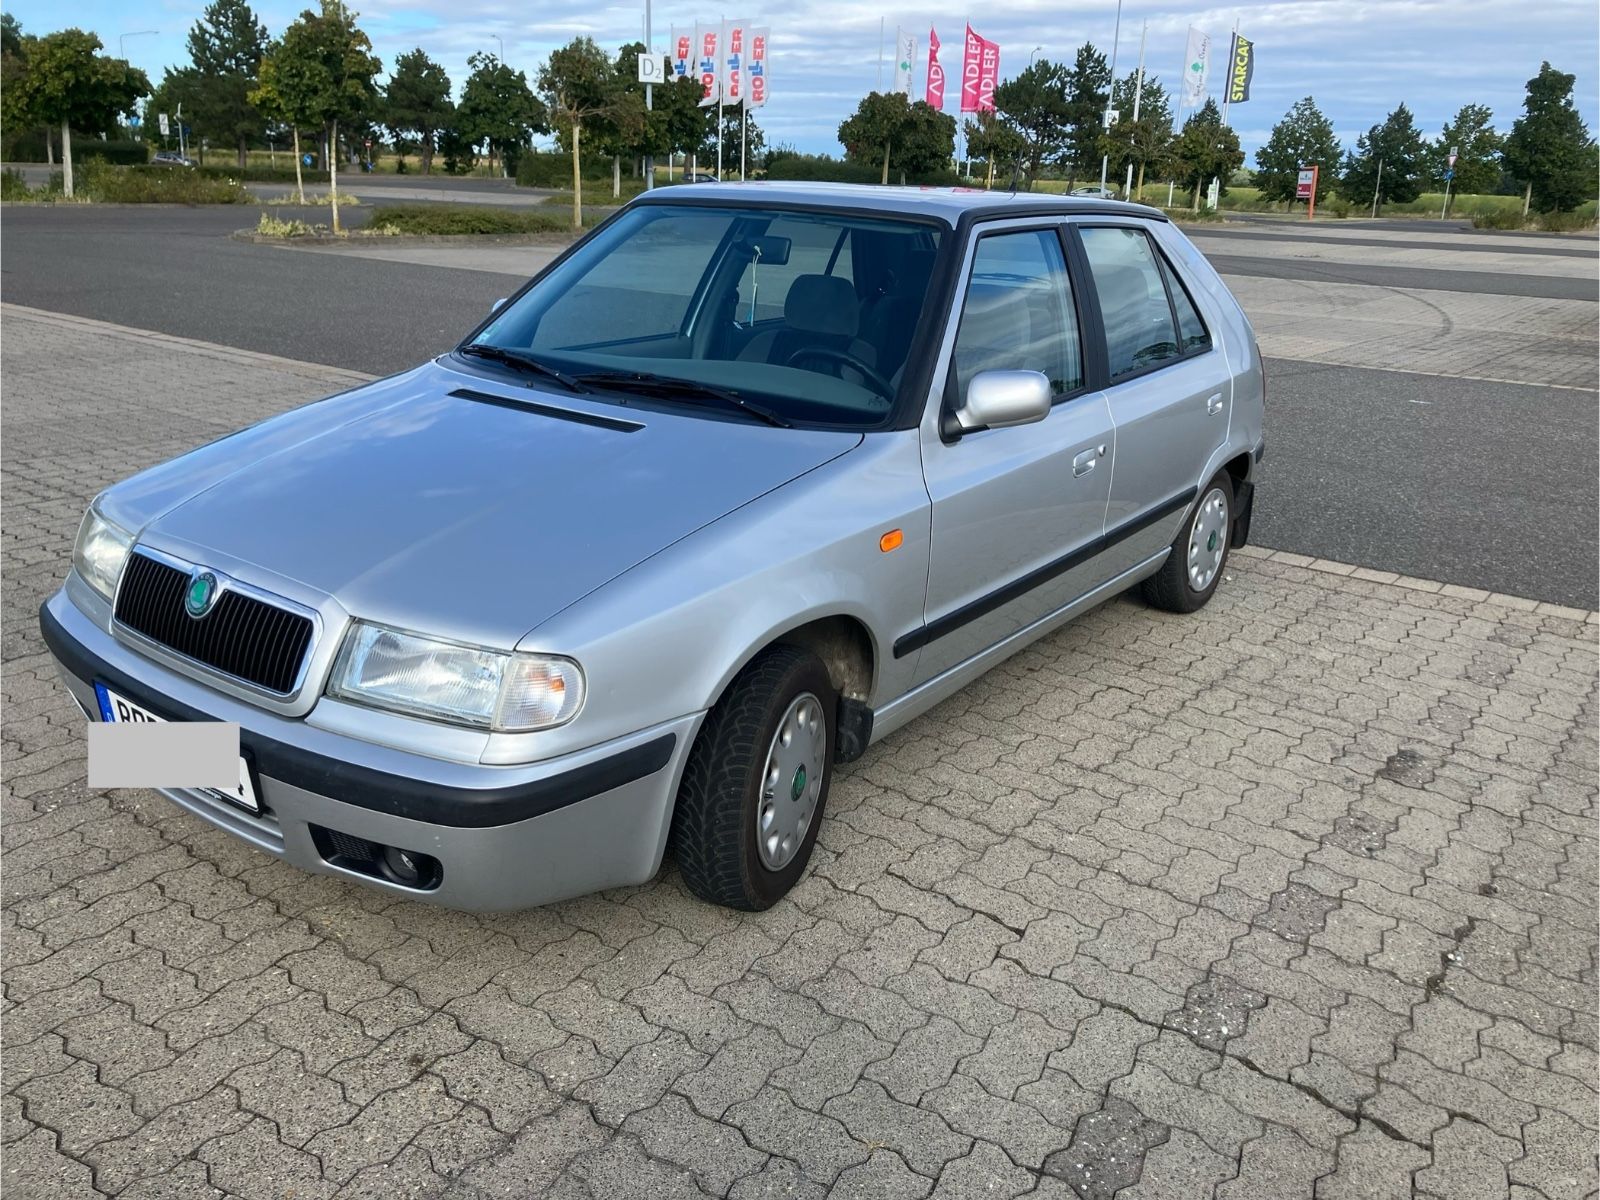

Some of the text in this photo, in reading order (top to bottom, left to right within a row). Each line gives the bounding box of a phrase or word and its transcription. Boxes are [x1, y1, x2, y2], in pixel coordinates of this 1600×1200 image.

[675, 36, 690, 75] LLER
[727, 28, 743, 97] ROLLER
[747, 36, 765, 102] ROLLER
[979, 48, 996, 106] ADLER
[1231, 36, 1250, 101] STARCAR
